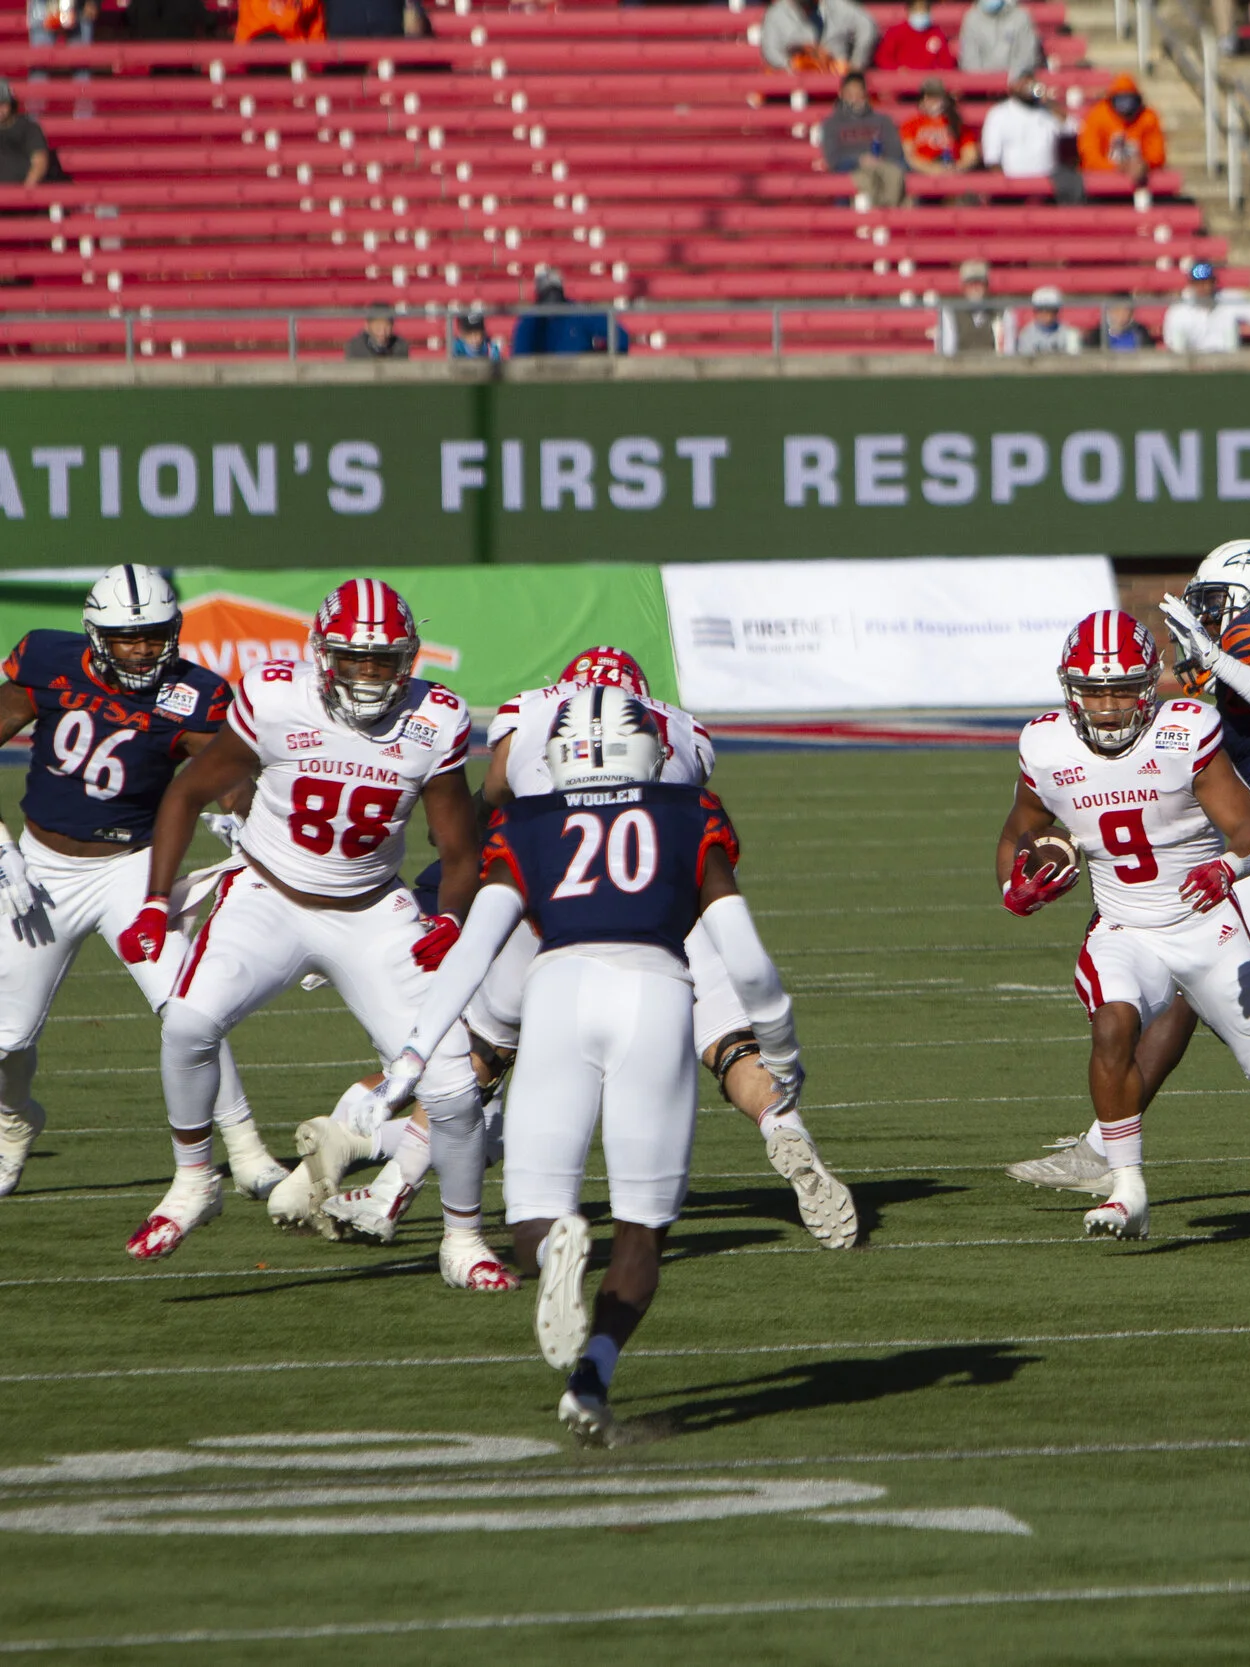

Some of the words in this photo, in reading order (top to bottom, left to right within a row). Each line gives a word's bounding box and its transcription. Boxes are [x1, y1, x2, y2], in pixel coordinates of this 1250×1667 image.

[0, 441, 383, 519] TION'S
[441, 436, 729, 512] FIRST
[591, 665, 620, 682] 74
[58, 690, 149, 732] UTSA
[46, 709, 138, 801] 96
[298, 759, 399, 785] LOUISIANA
[288, 776, 404, 859] 88
[564, 787, 643, 807] WOOLEN
[1072, 789, 1159, 810] LOUISIANA
[550, 808, 658, 900] 20
[1098, 808, 1159, 884] 9
